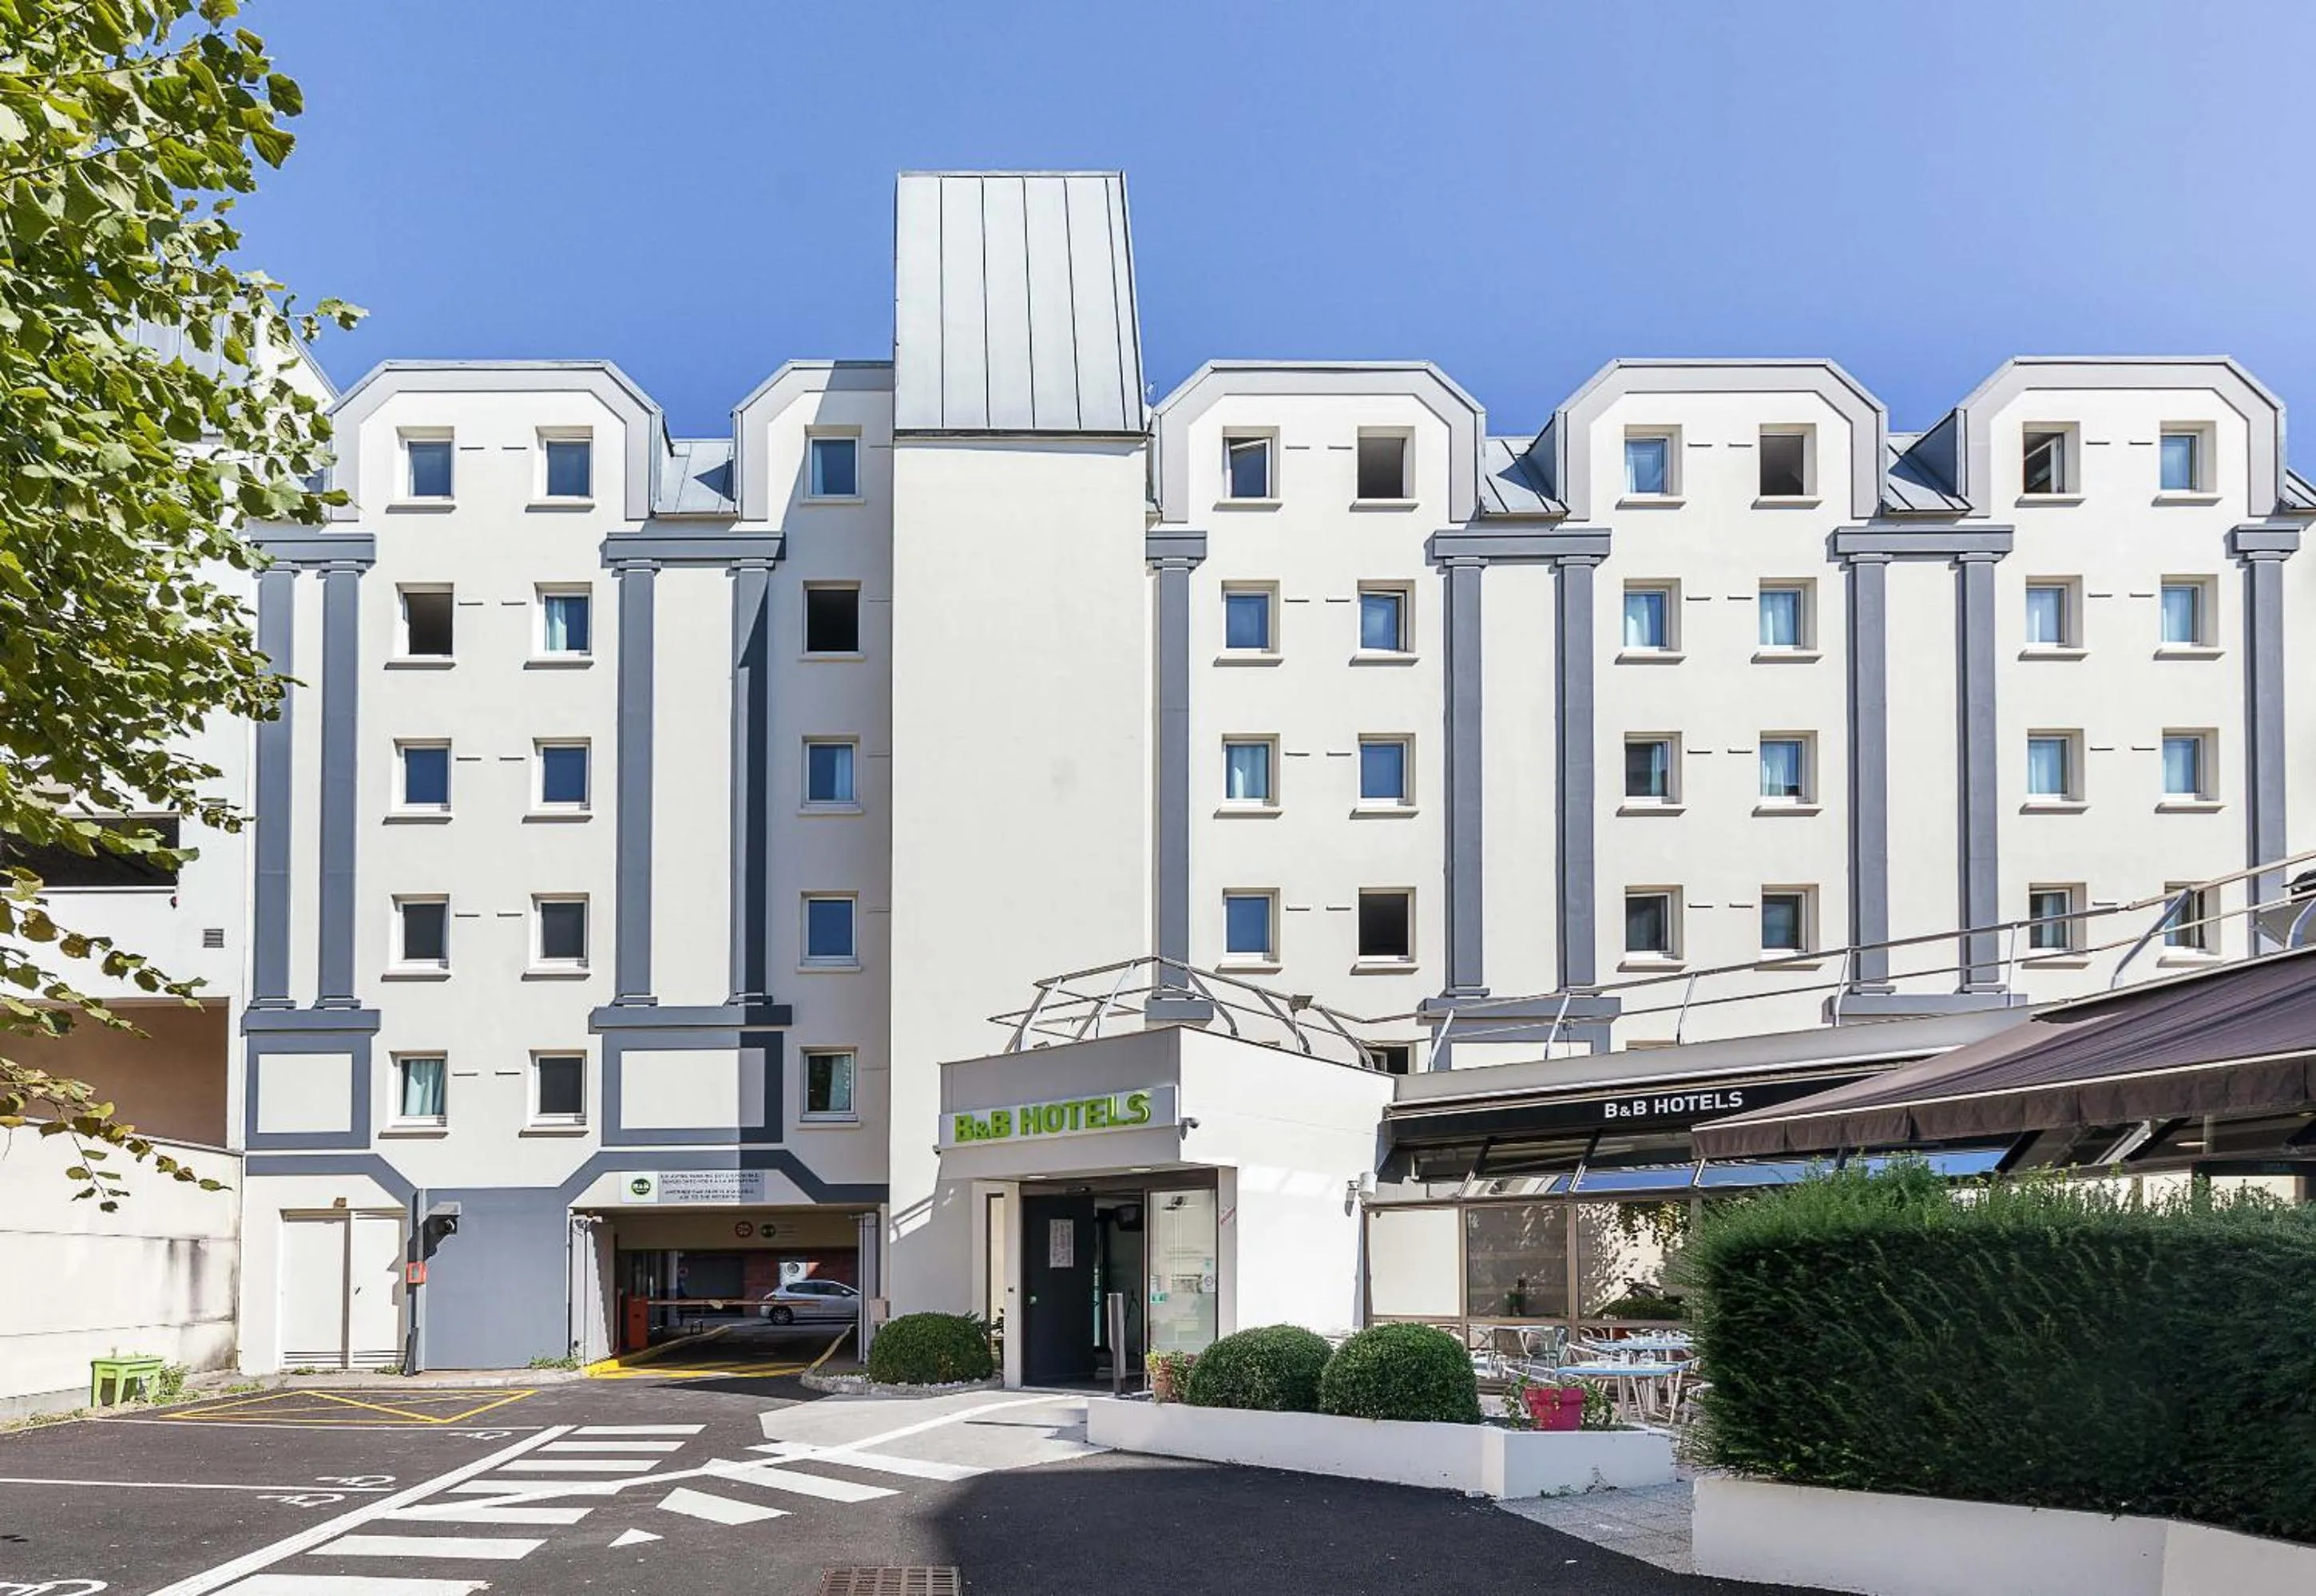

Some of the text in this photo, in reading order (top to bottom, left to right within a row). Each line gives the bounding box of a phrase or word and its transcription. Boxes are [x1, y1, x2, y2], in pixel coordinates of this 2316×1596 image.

[955, 1093, 1151, 1143] B&B HOTELS
[1604, 1091, 1743, 1119] B&B HOTELS
